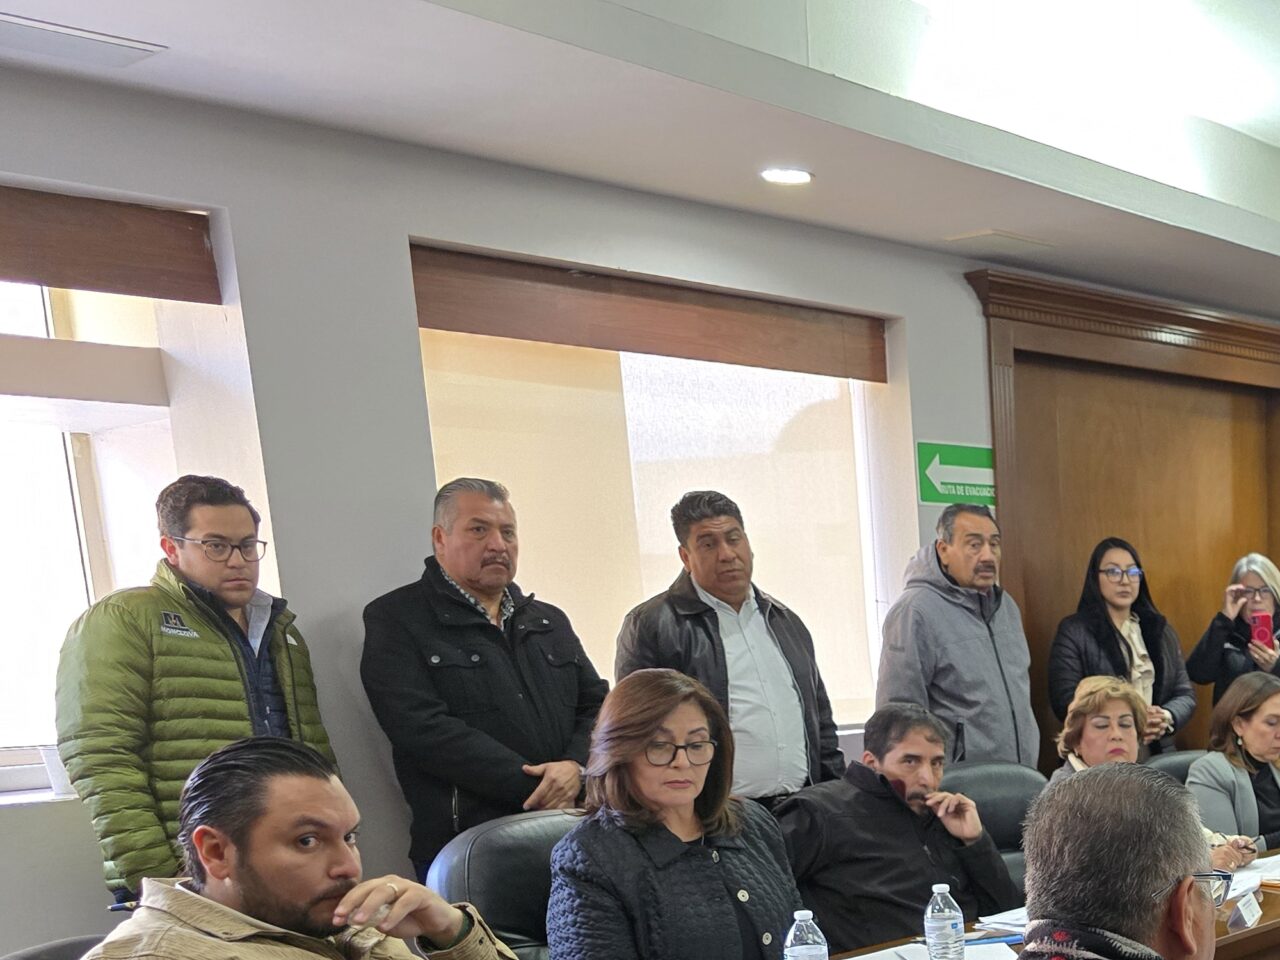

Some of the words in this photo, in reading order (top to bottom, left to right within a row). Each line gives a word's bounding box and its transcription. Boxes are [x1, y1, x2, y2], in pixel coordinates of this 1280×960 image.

[956, 485, 964, 496] DE
[965, 486, 996, 497] EVACUACI
[160, 625, 200, 637] MONCLOVA
